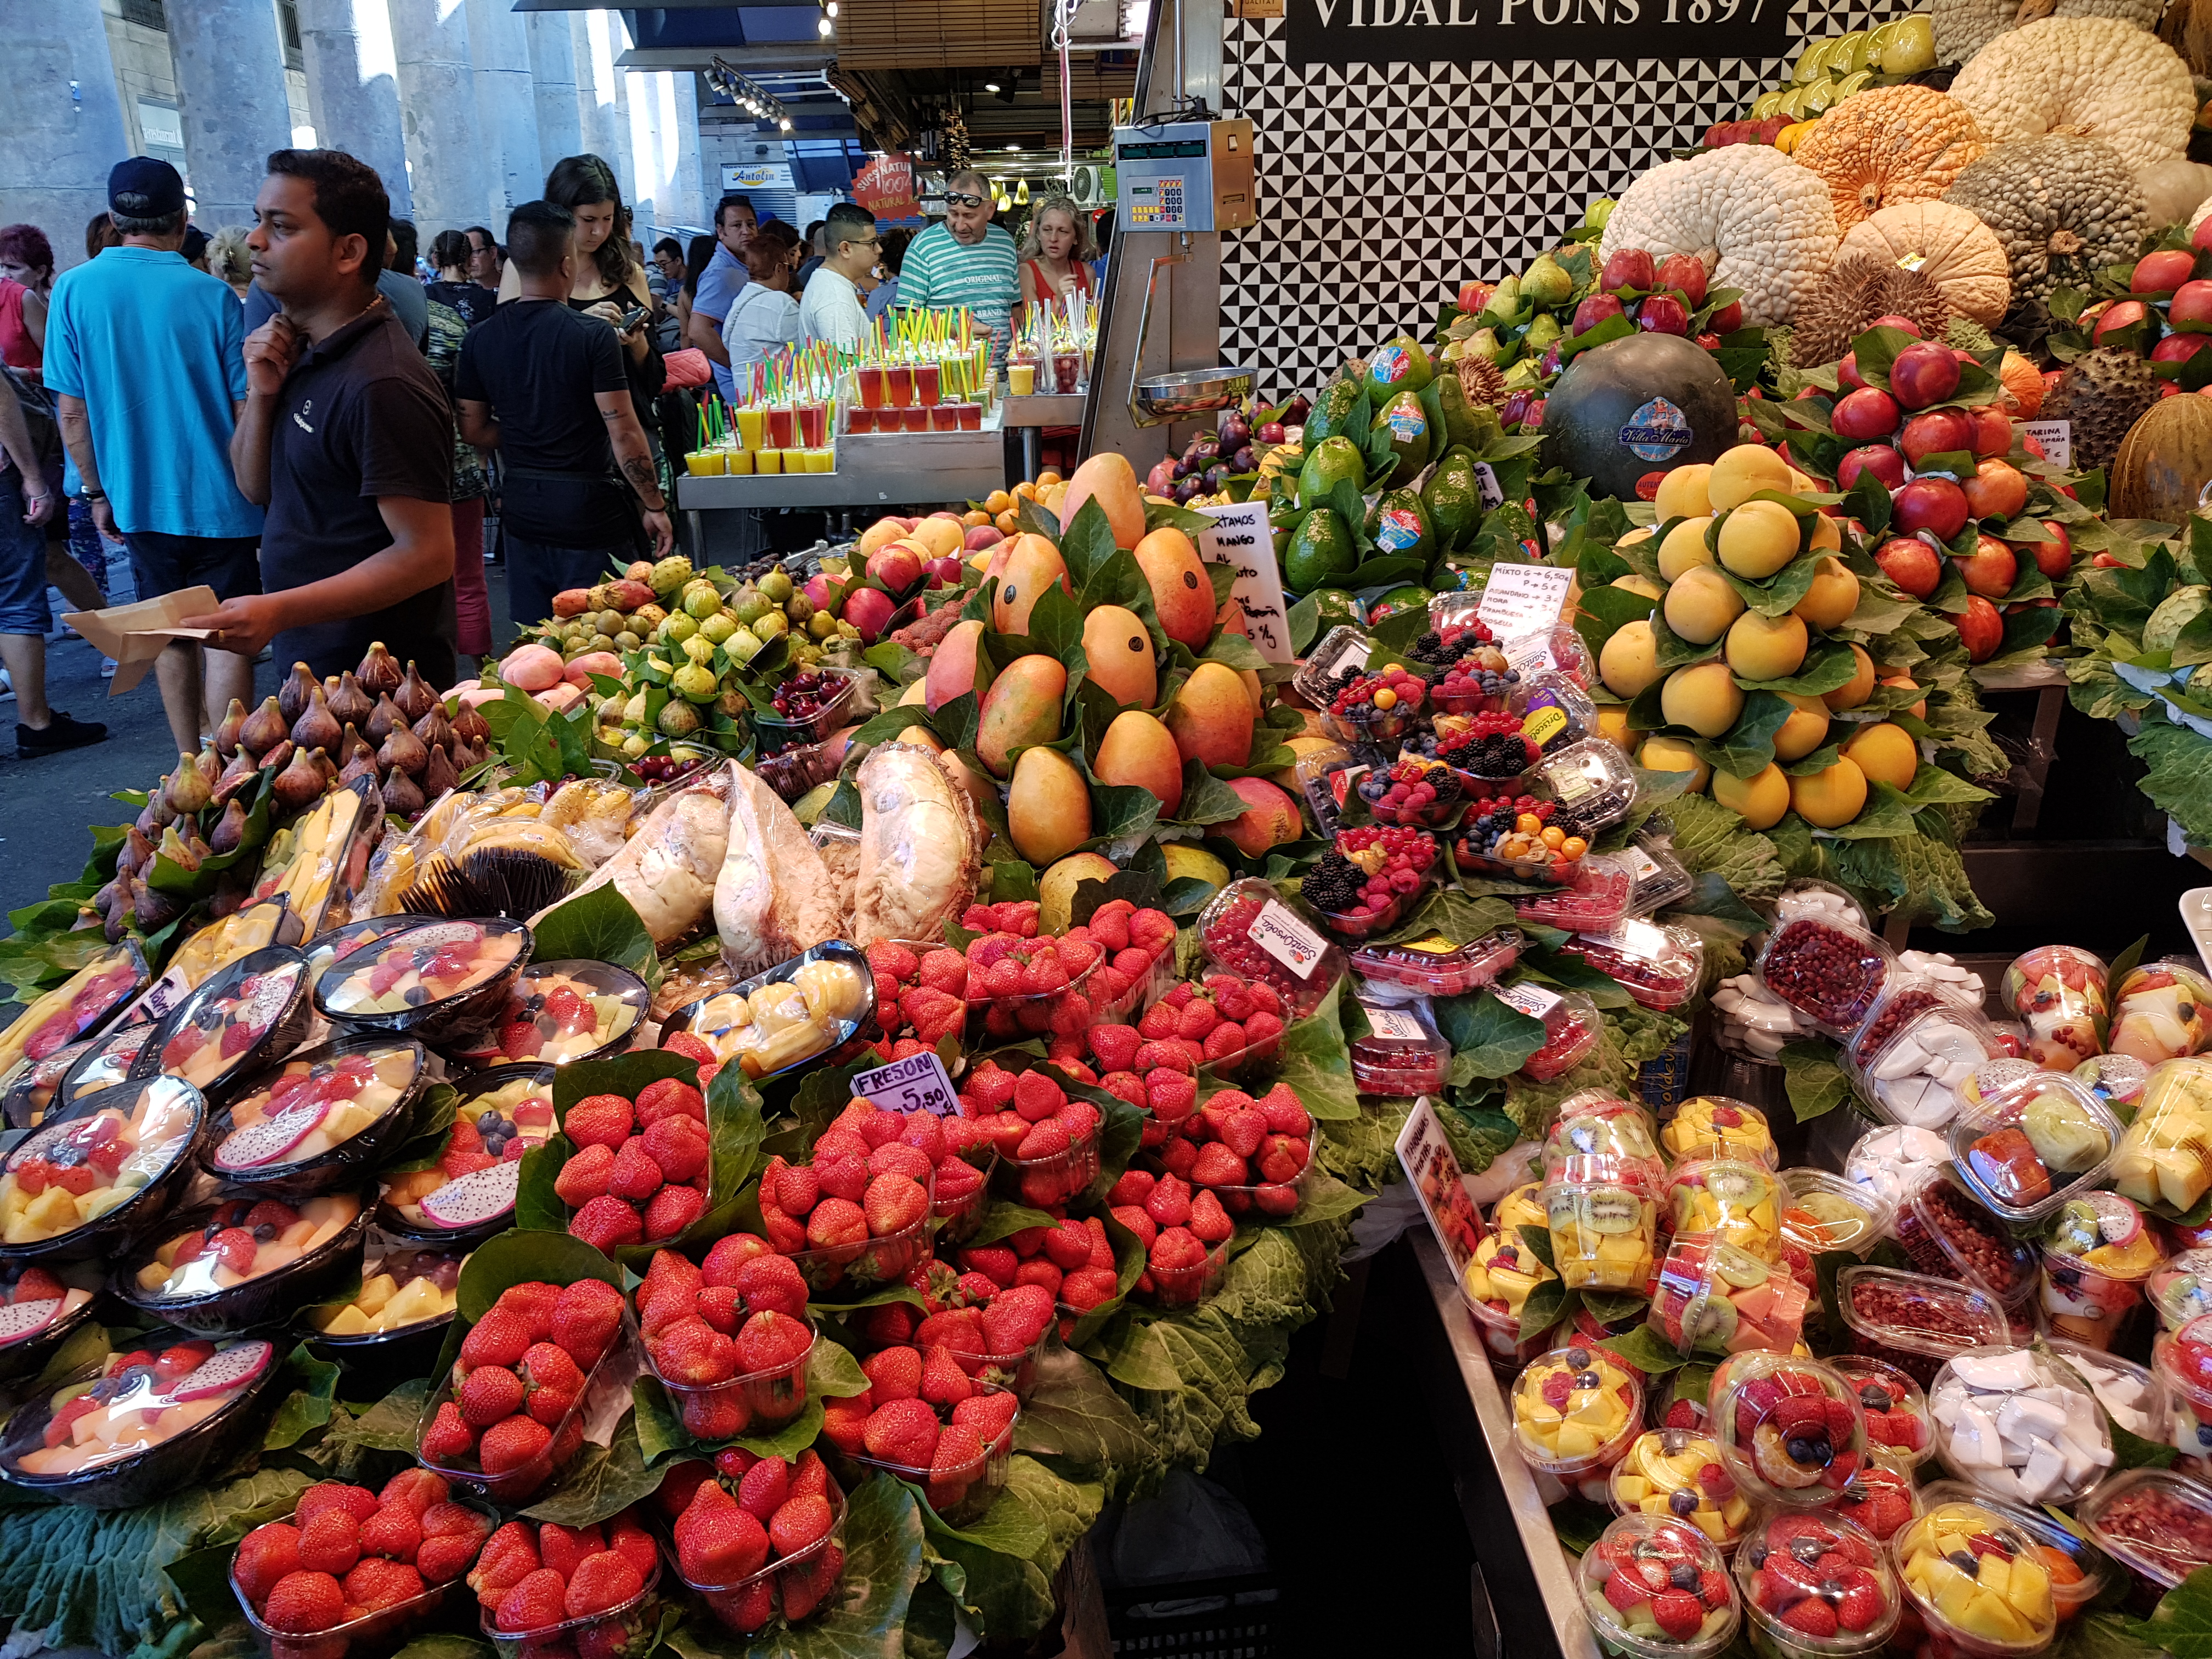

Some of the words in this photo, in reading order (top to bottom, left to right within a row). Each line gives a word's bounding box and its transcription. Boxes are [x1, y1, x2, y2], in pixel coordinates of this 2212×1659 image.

[1316, 0, 1479, 28] VIDAL
[1497, 0, 1640, 25] PONS
[1661, 0, 1764, 24] 1897
[868, 195, 905, 211] NATURAL
[964, 274, 1002, 284] ORIGINAL
[977, 308, 1002, 318] BRAND
[1623, 428, 1649, 442] Villa
[1216, 534, 1255, 547] MANGO
[1216, 553, 1231, 564] AL
[1481, 606, 1524, 618] FRAMBUESA
[1262, 919, 1316, 961] SantOrsola
